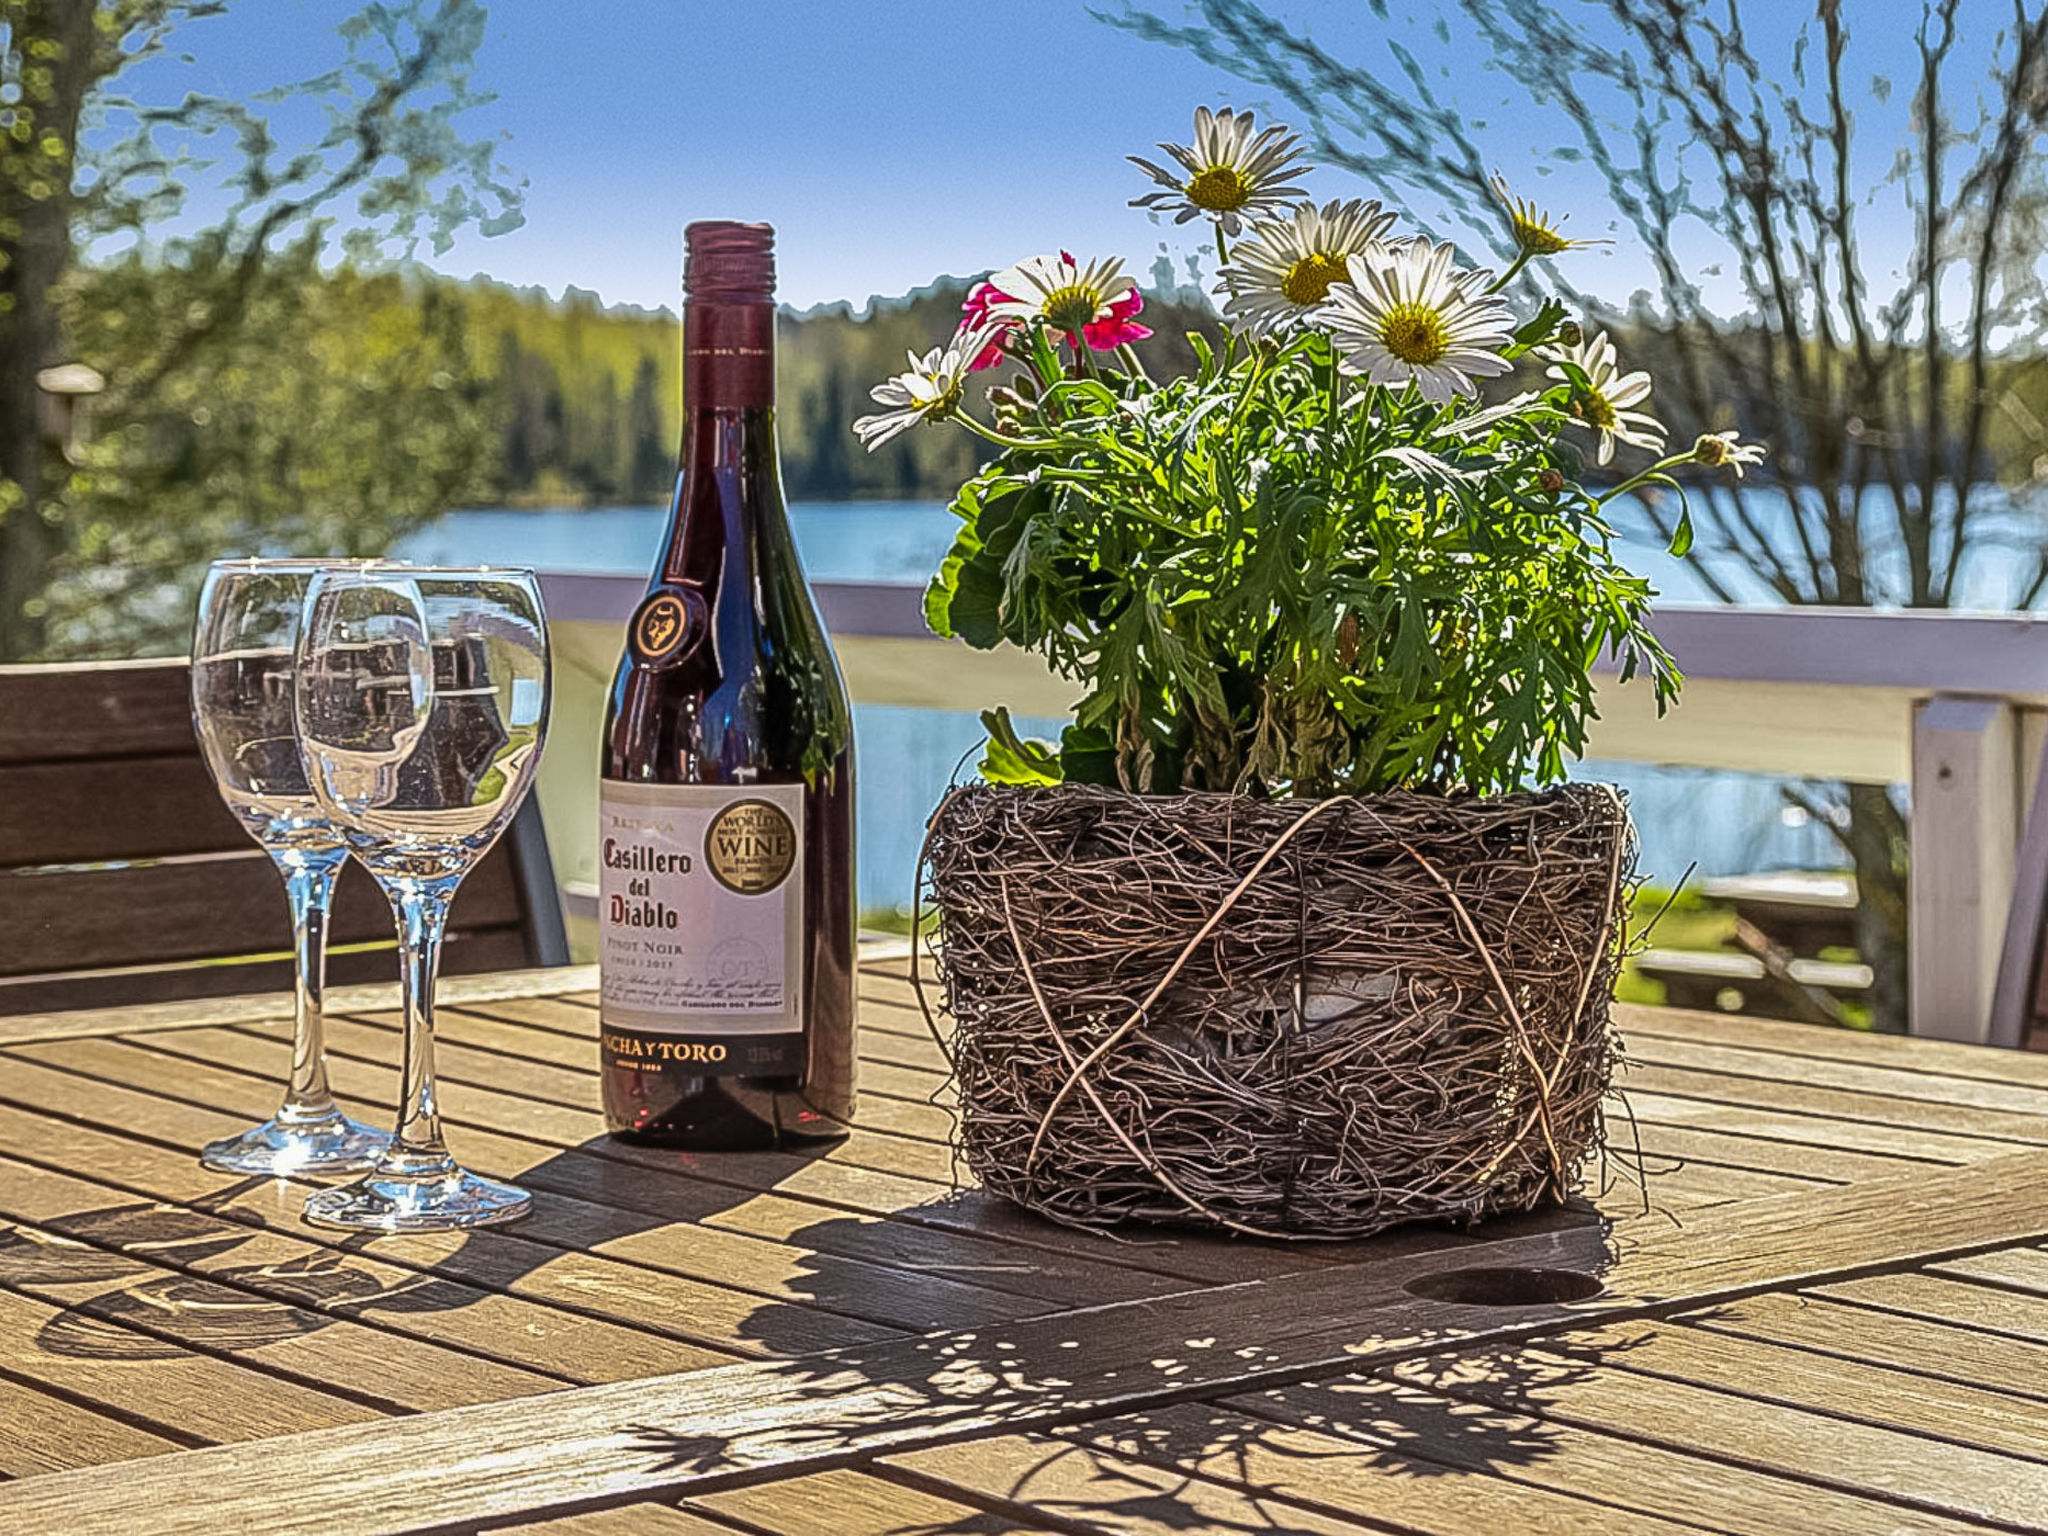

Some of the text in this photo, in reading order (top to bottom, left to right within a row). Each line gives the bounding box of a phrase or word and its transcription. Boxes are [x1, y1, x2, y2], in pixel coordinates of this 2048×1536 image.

[603, 837, 692, 874] Casillero
[717, 836, 788, 857] WINE
[629, 878, 650, 896] del
[611, 894, 678, 929] Diablo
[643, 939, 684, 955] NOIR
[657, 1042, 727, 1063] TORO
